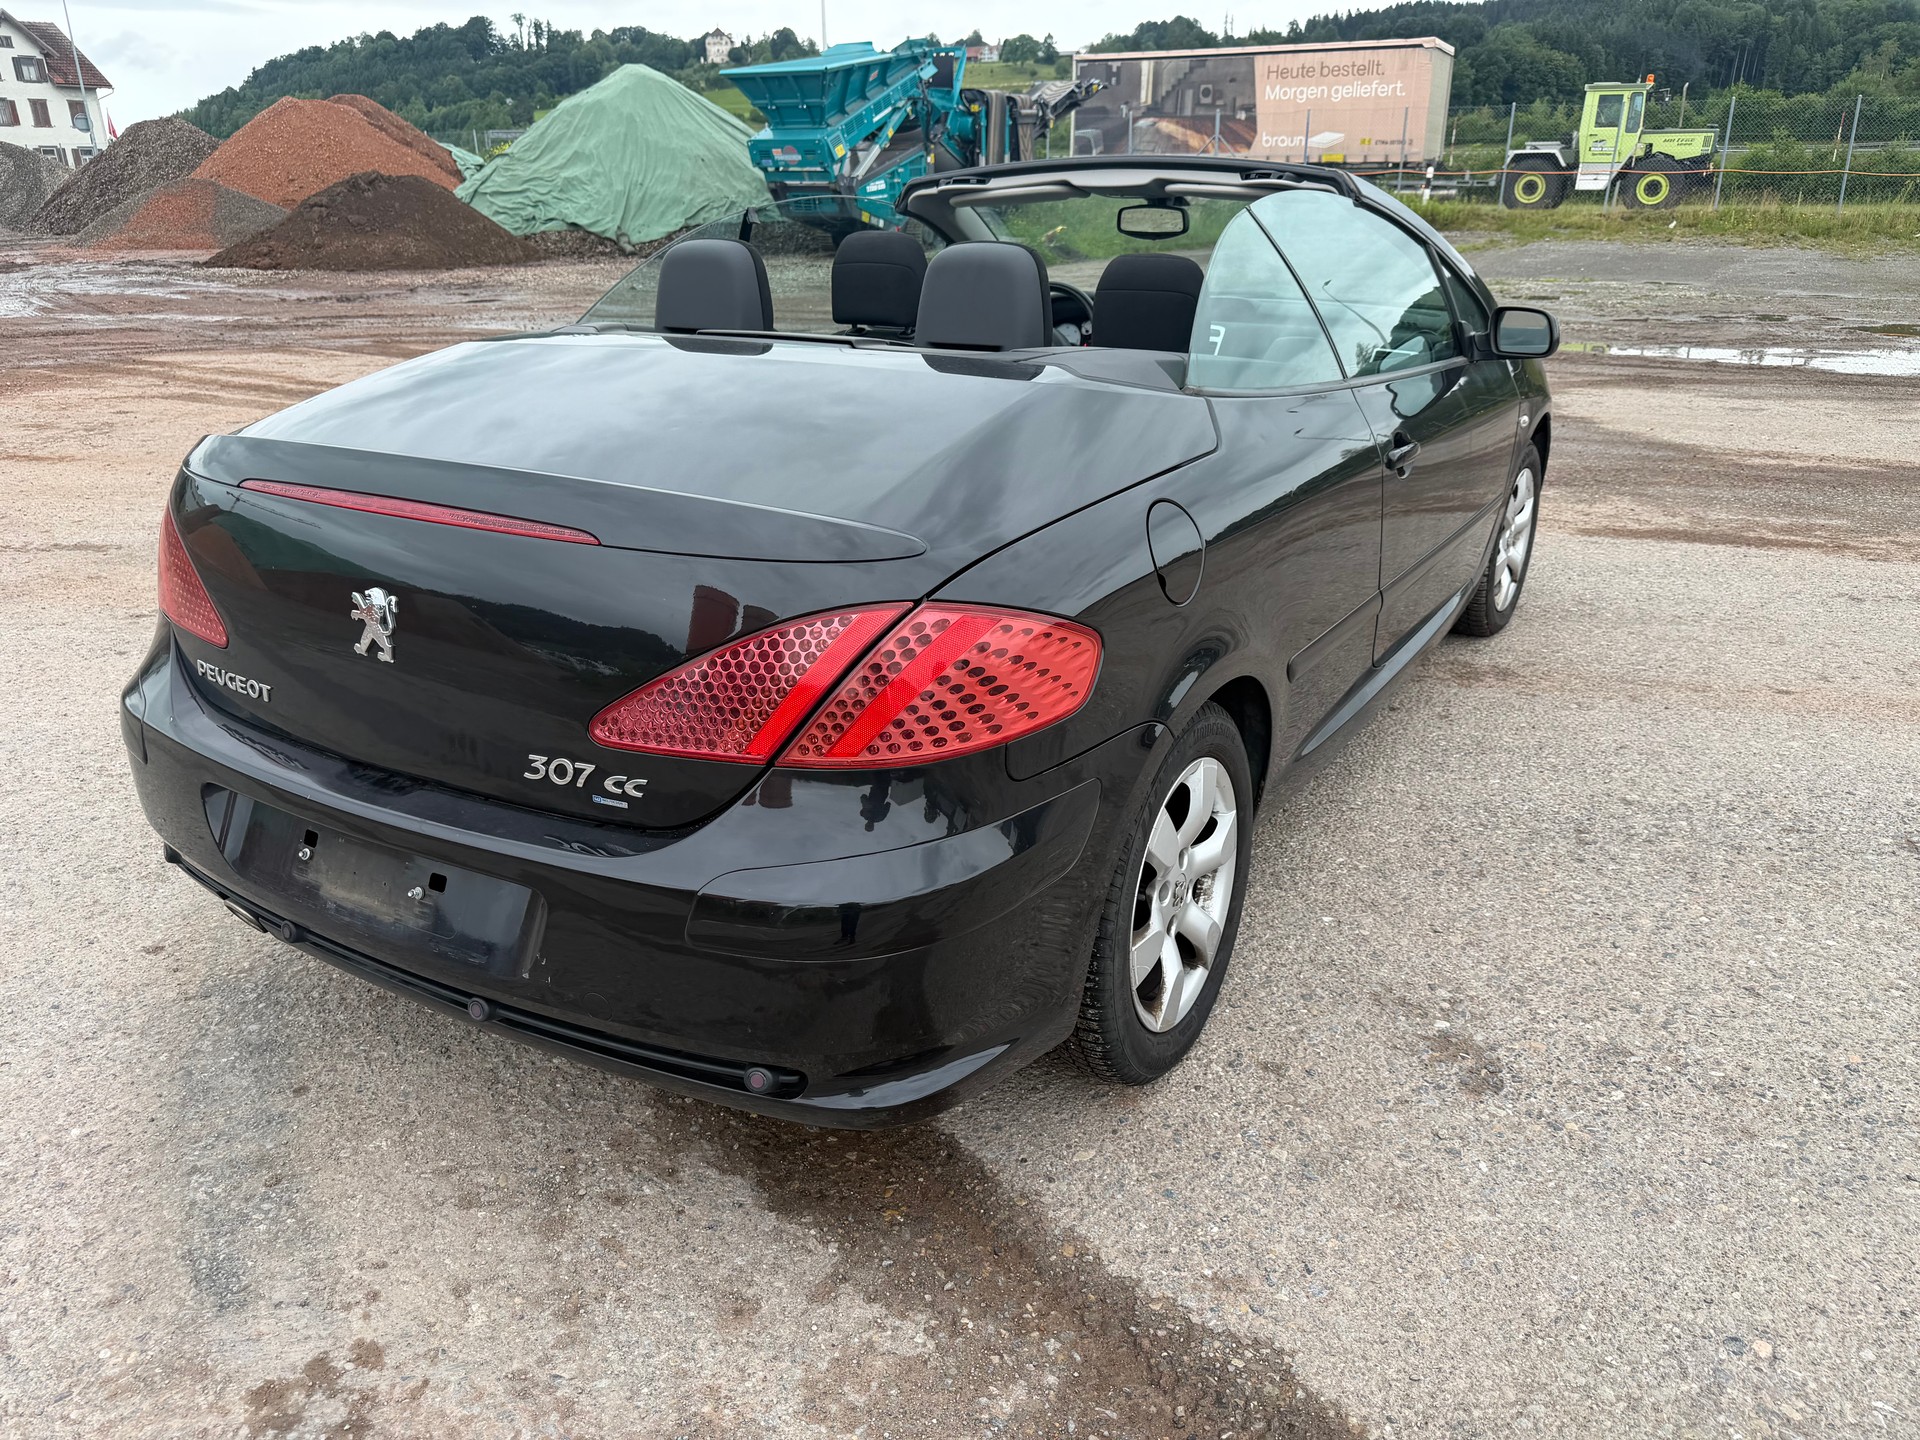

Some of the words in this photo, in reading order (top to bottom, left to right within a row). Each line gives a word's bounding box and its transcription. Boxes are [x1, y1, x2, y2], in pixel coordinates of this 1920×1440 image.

[1266, 62, 1316, 80] Heute
[1320, 59, 1385, 78] bestellt.
[1264, 84, 1328, 103] Morgen
[1331, 80, 1406, 102] geliefert.
[1261, 132, 1305, 147] braun
[196, 659, 272, 703] PEUGEOT
[523, 754, 596, 788] 307
